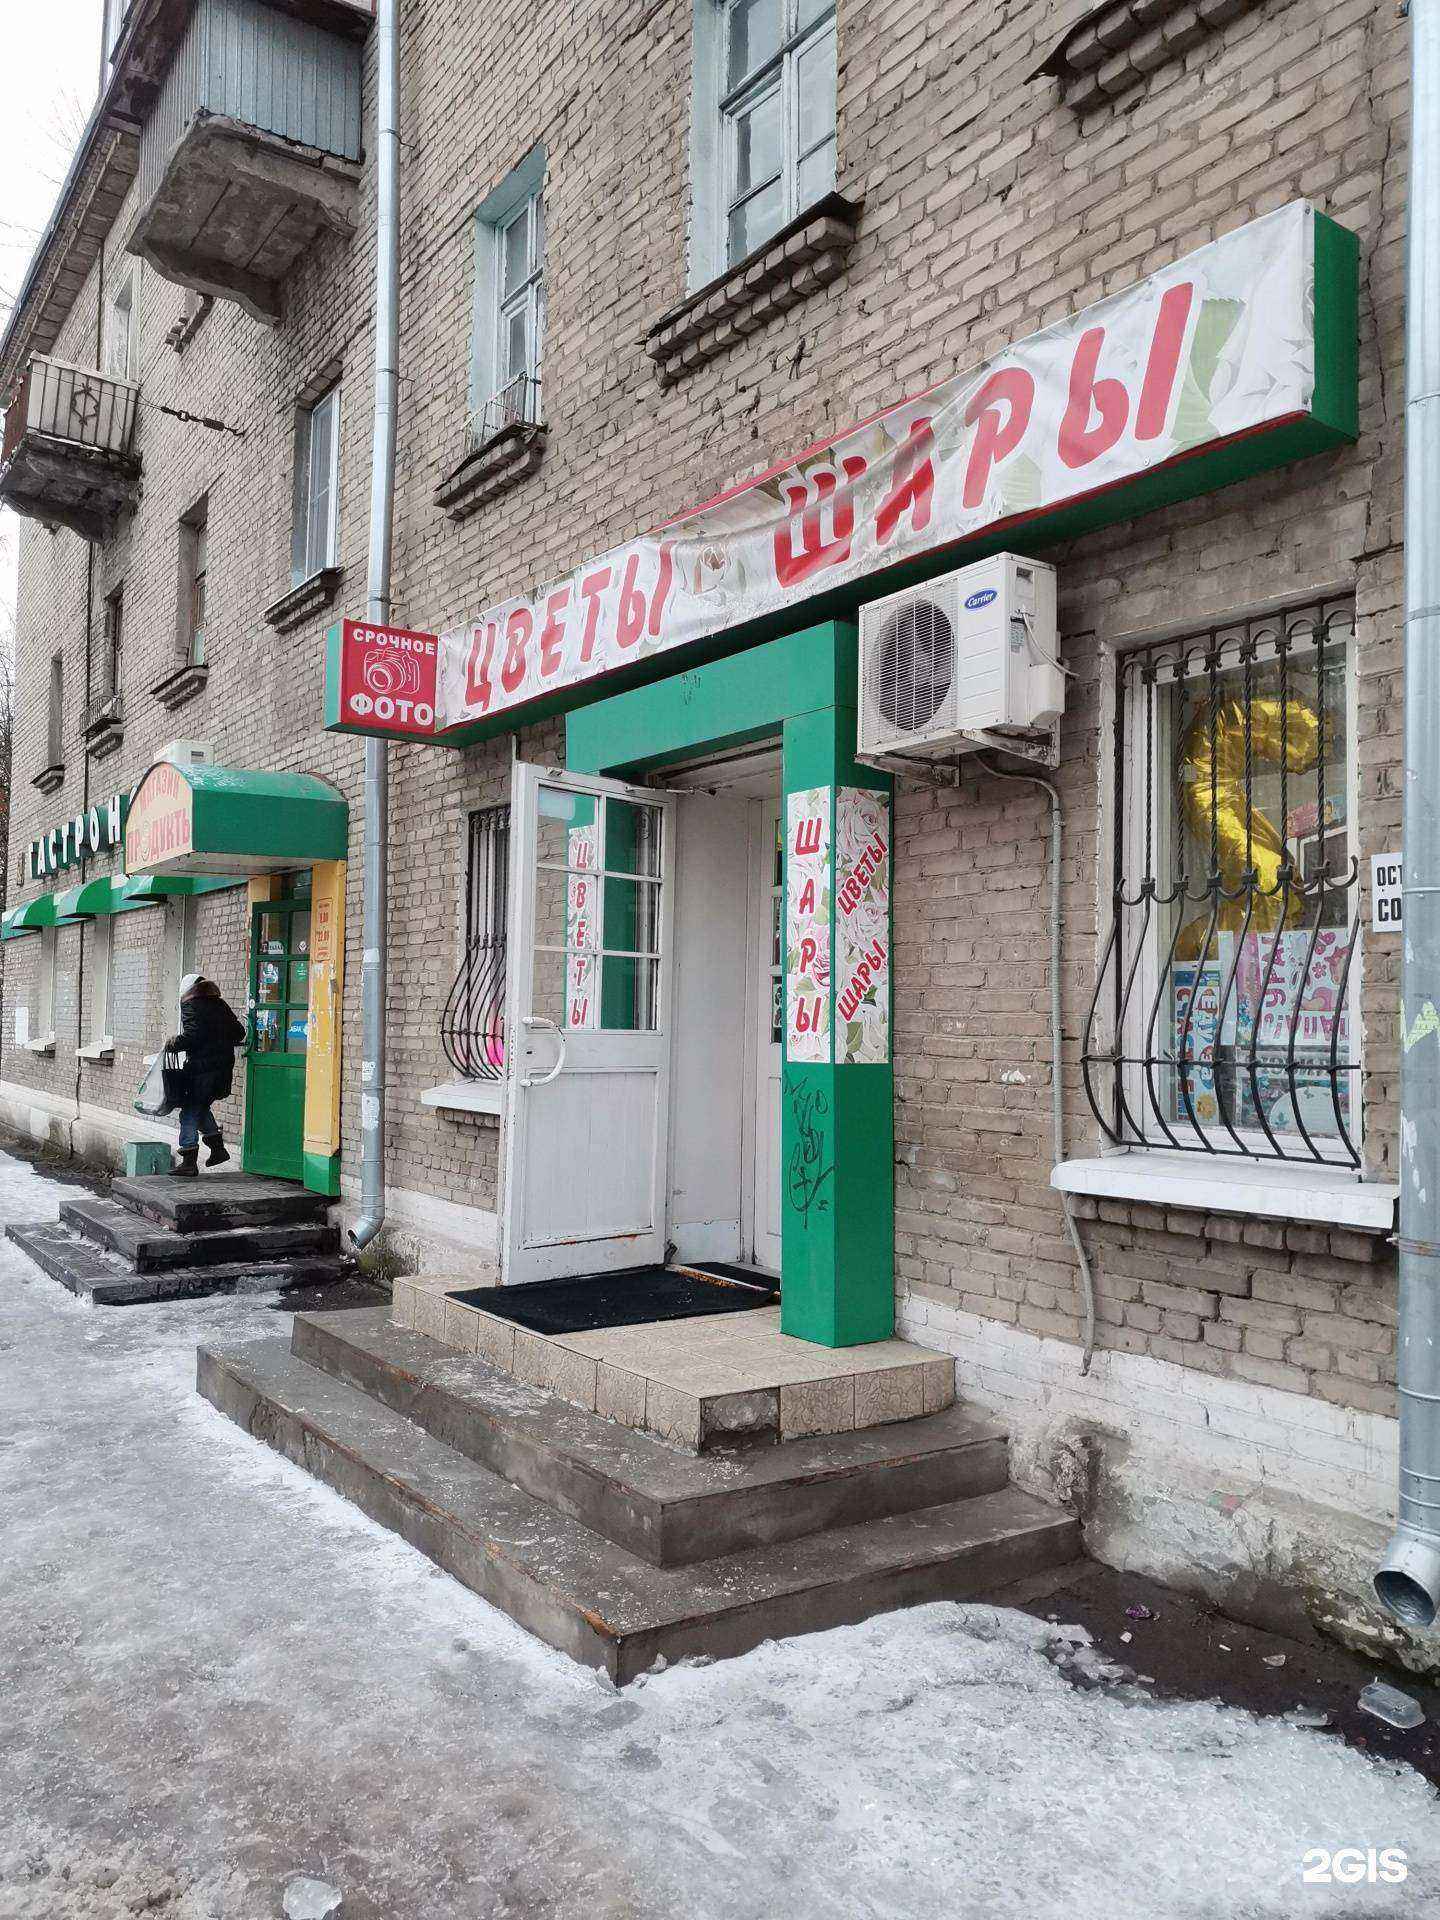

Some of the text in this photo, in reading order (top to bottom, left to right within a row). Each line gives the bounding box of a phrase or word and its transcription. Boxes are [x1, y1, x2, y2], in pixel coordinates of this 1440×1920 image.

[465, 281, 1193, 711] ЦВЕТЫ ШАРЫ
[967, 592, 994, 607] Carrier
[352, 628, 435, 656] СРОЧНОЕ
[350, 692, 434, 726] ФОТО
[837, 832, 888, 916] ЦВЕТЫ
[795, 817, 822, 1033] ШАРЫ
[837, 938, 887, 1022] ШАРЫ
